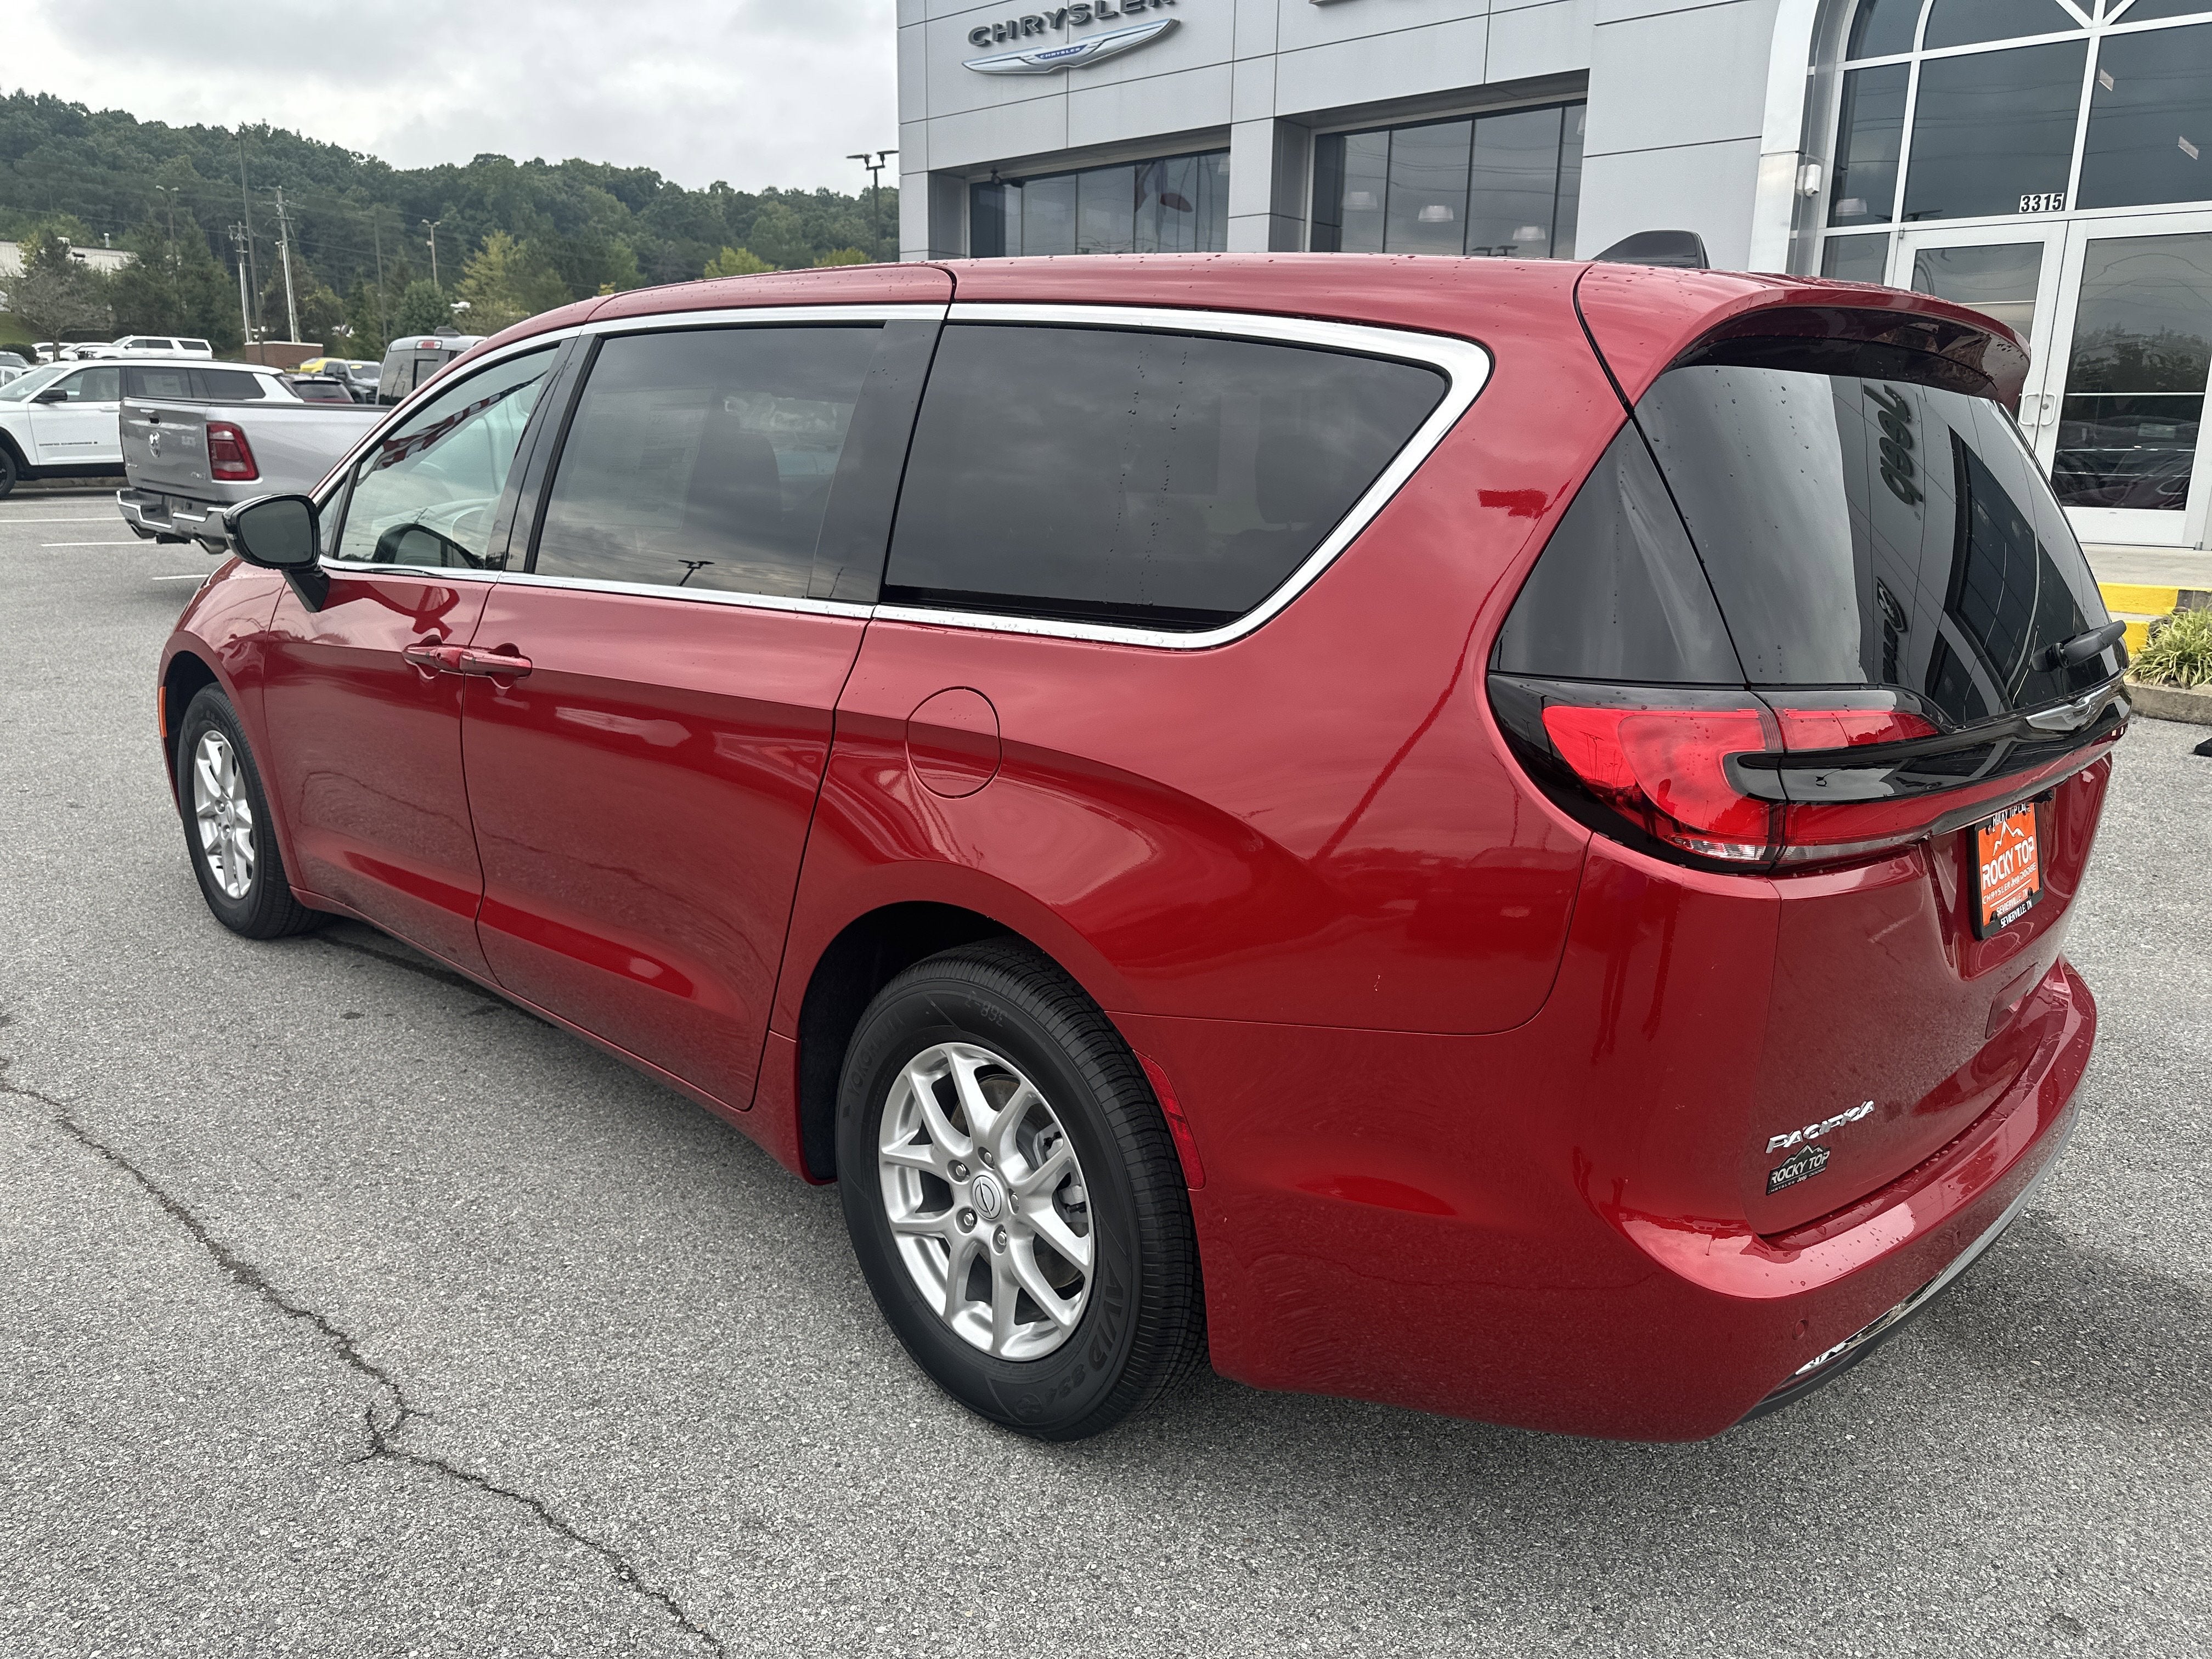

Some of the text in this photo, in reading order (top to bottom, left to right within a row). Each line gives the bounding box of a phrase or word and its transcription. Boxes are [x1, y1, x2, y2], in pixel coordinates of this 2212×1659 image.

[2021, 194, 2062, 212] 3315
[1982, 836, 2034, 890] ROCKY TOP
[1982, 861, 2036, 905] CHRYSLER Jeep DODGE
[2026, 899, 2032, 910] TN
[1765, 1100, 1875, 1154] PACIFICA
[1770, 1159, 1808, 1185] ROCKY
[1809, 1150, 1831, 1170] TOP
[1088, 1257, 1124, 1370] AVID
